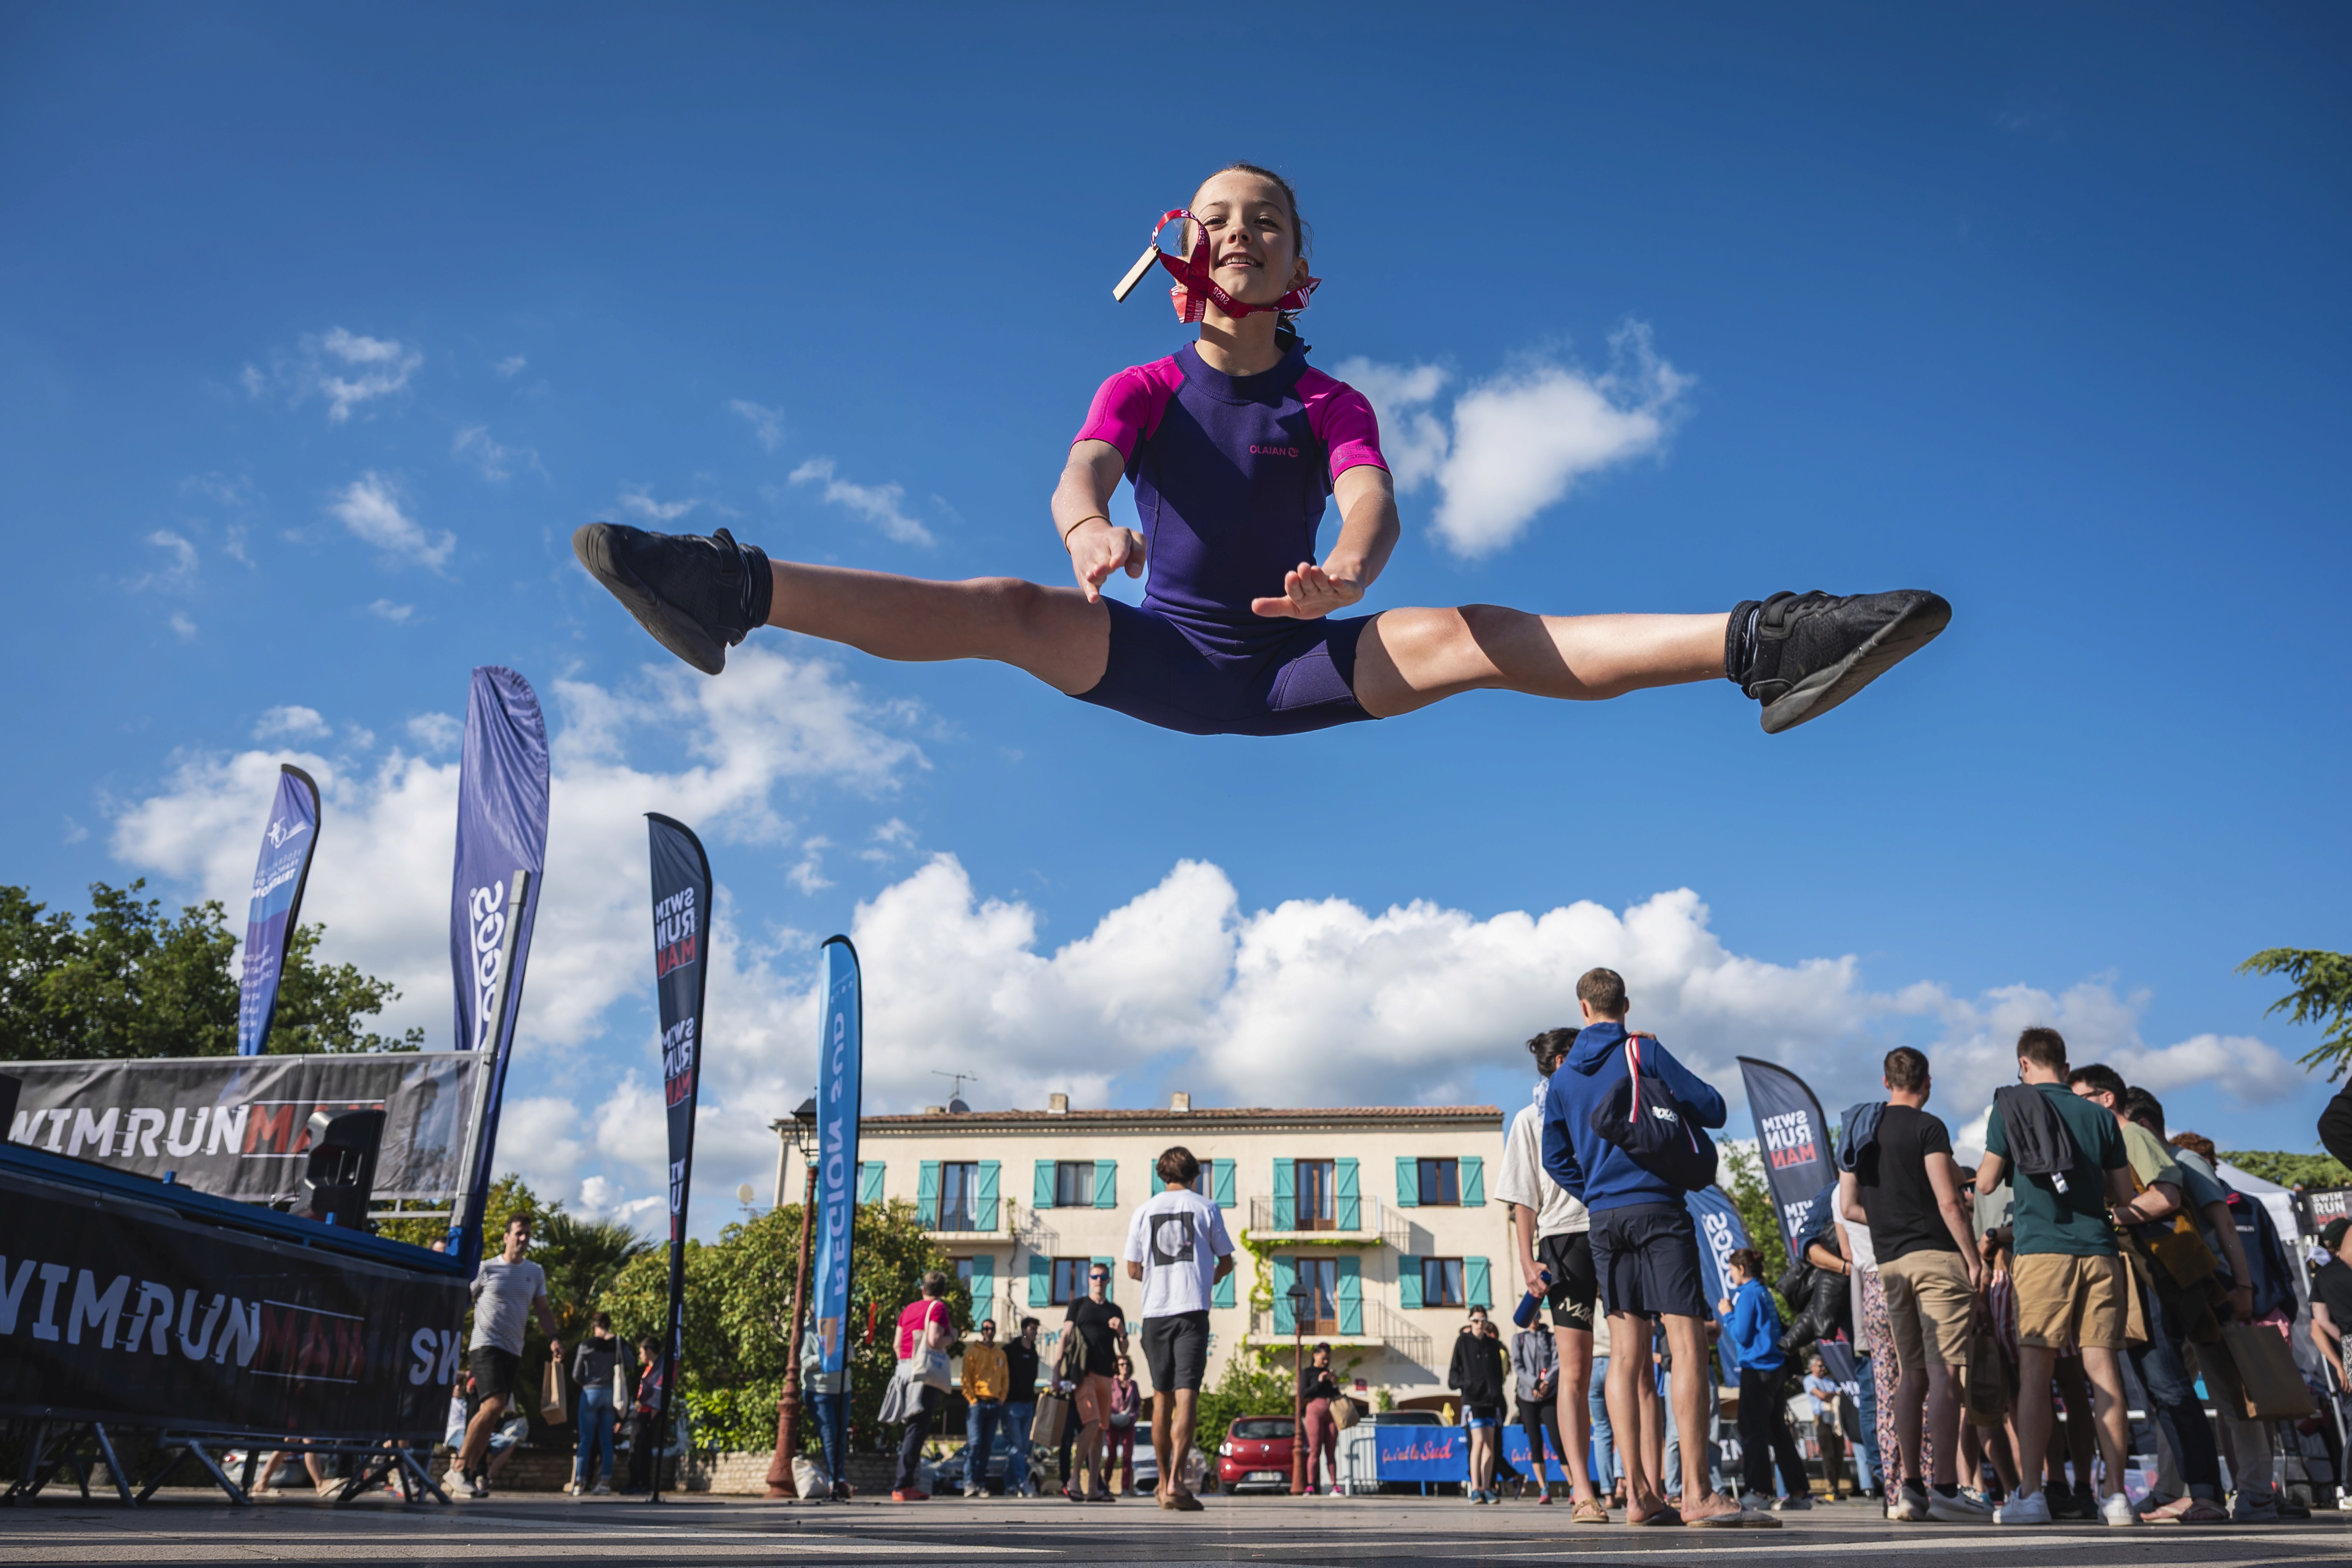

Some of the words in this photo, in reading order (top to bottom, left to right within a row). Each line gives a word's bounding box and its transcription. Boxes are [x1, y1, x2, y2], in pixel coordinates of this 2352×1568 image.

[1212, 286, 1230, 305] 2025
[1249, 444, 1286, 456] OLAIAN
[2311, 1191, 2344, 1203] SWIM
[2313, 1201, 2346, 1215] RUN
[1420, 1437, 1453, 1461] Sud
